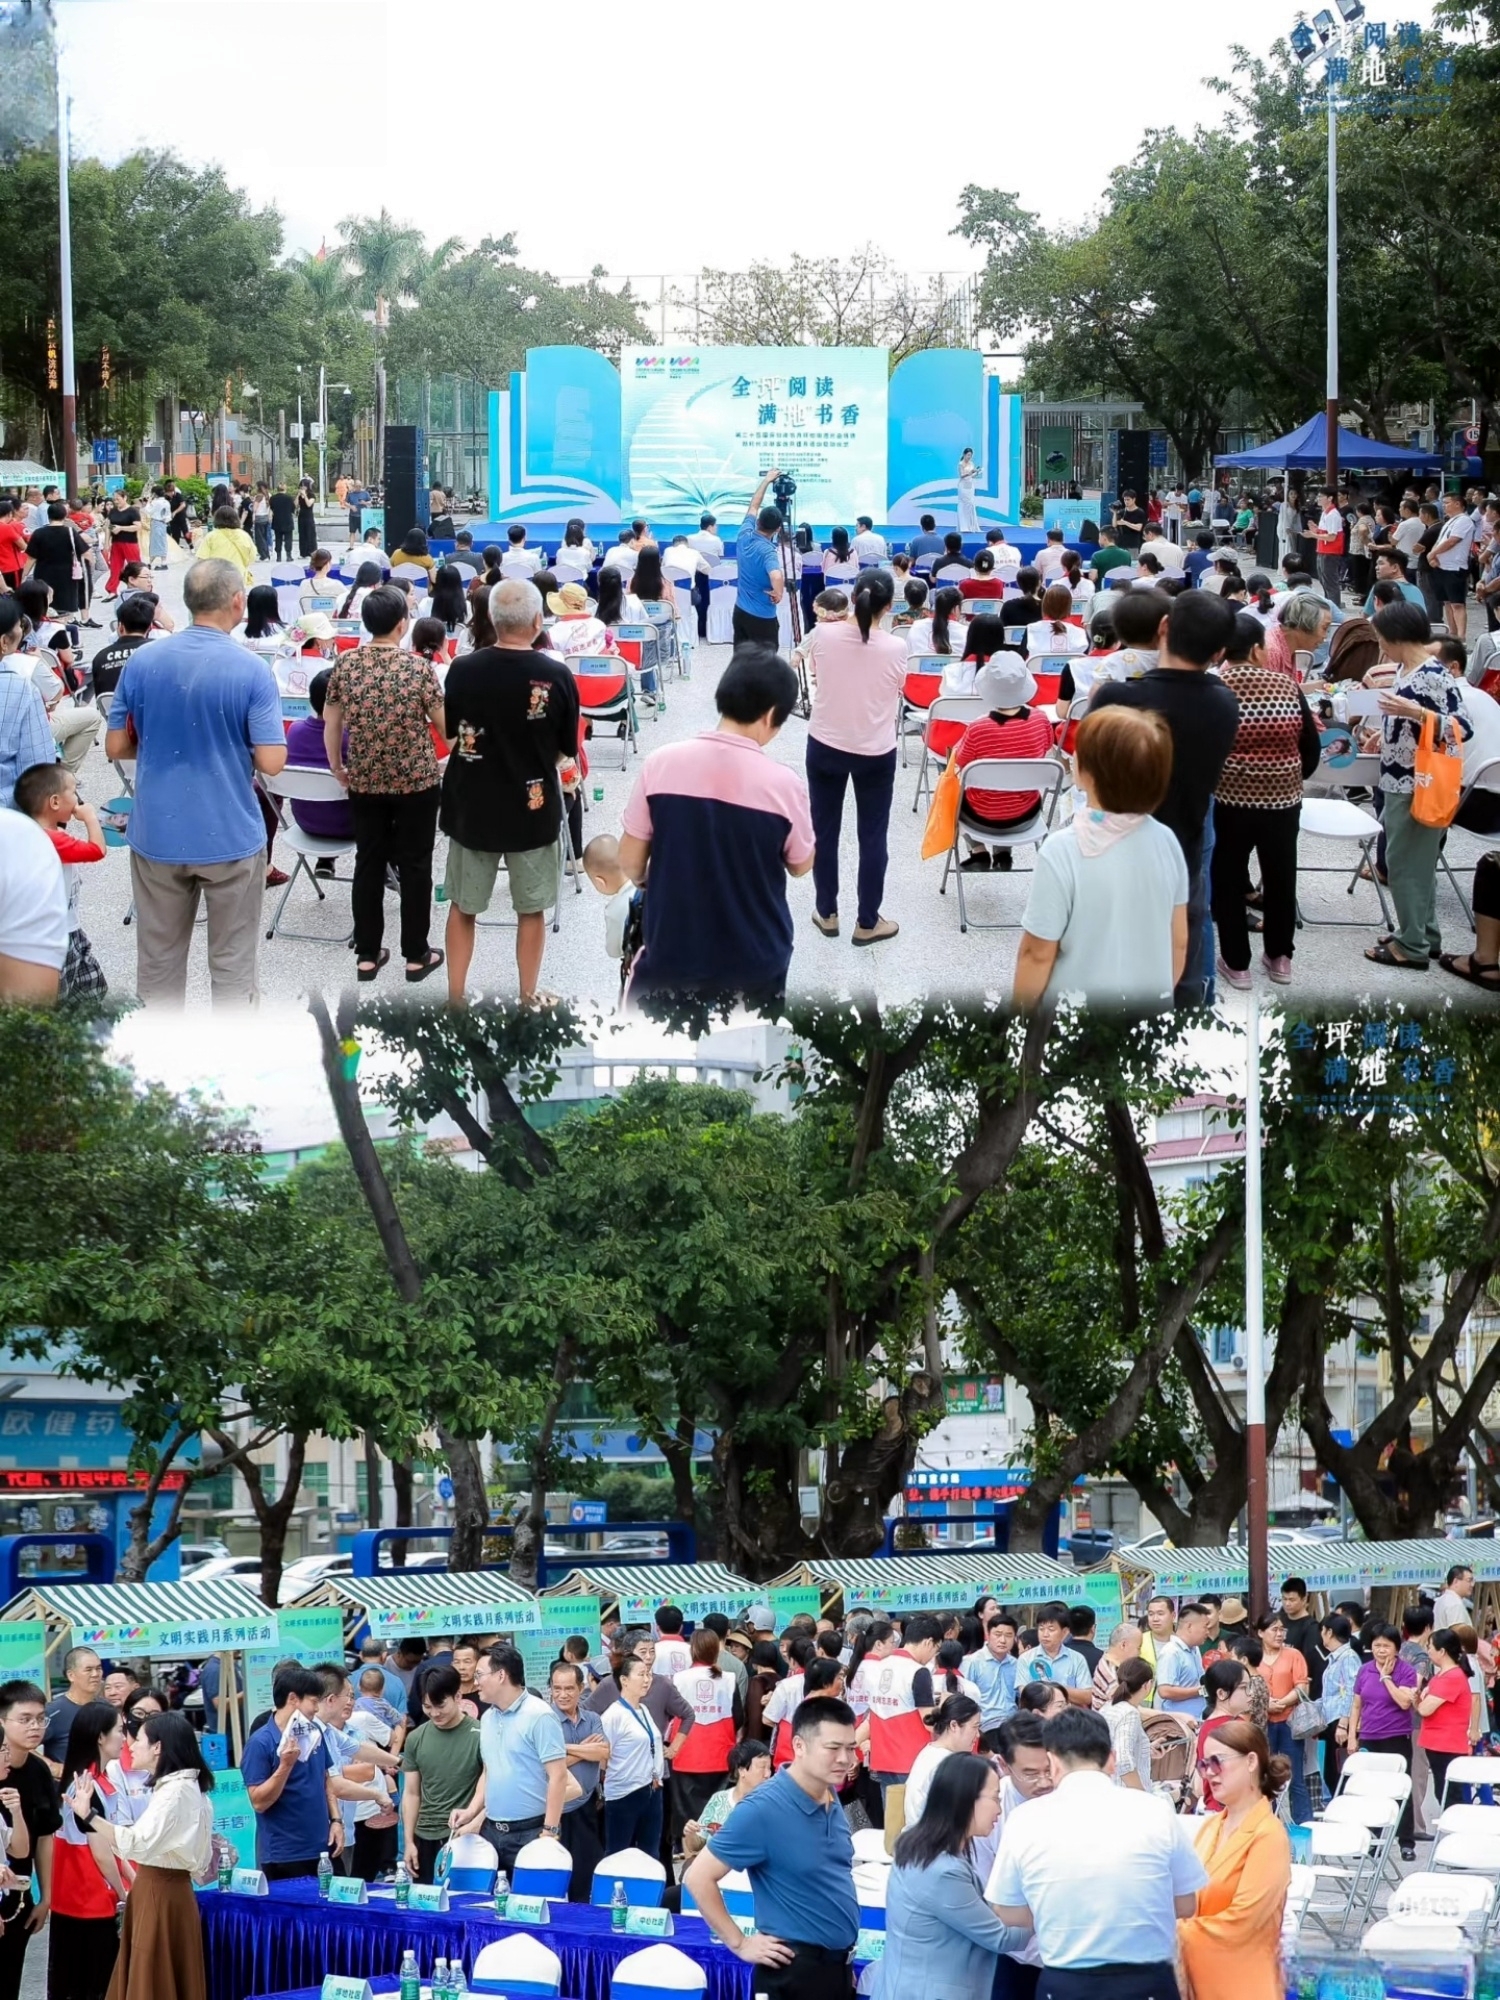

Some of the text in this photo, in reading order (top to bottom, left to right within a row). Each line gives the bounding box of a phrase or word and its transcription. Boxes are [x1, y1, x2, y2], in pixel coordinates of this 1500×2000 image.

[2, 1410, 136, 1437] 欧健药
[897, 1590, 967, 1606] 文明实践月系列活动
[441, 1610, 535, 1629] 文明实践月系列活动
[158, 1625, 272, 1648] 文明实践月系列活动
